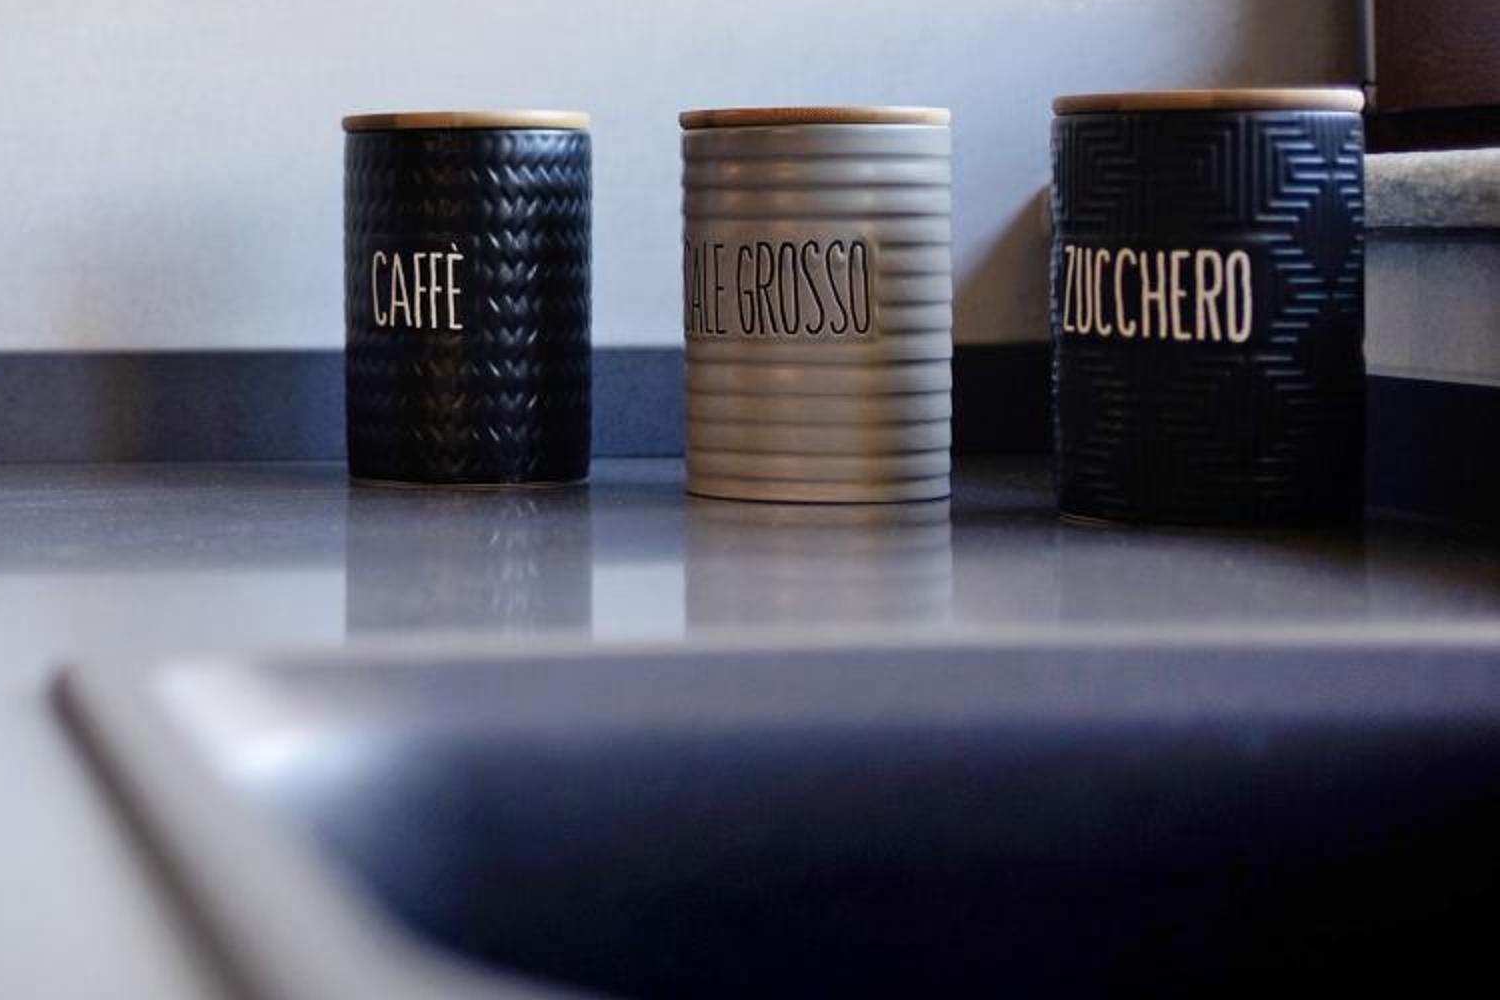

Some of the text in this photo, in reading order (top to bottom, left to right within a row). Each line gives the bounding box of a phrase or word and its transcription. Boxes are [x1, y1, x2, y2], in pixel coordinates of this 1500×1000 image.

[372, 242, 464, 330] CAFFÈ
[736, 240, 870, 335] GROSSO
[1063, 245, 1253, 343] ZUCCHERO
